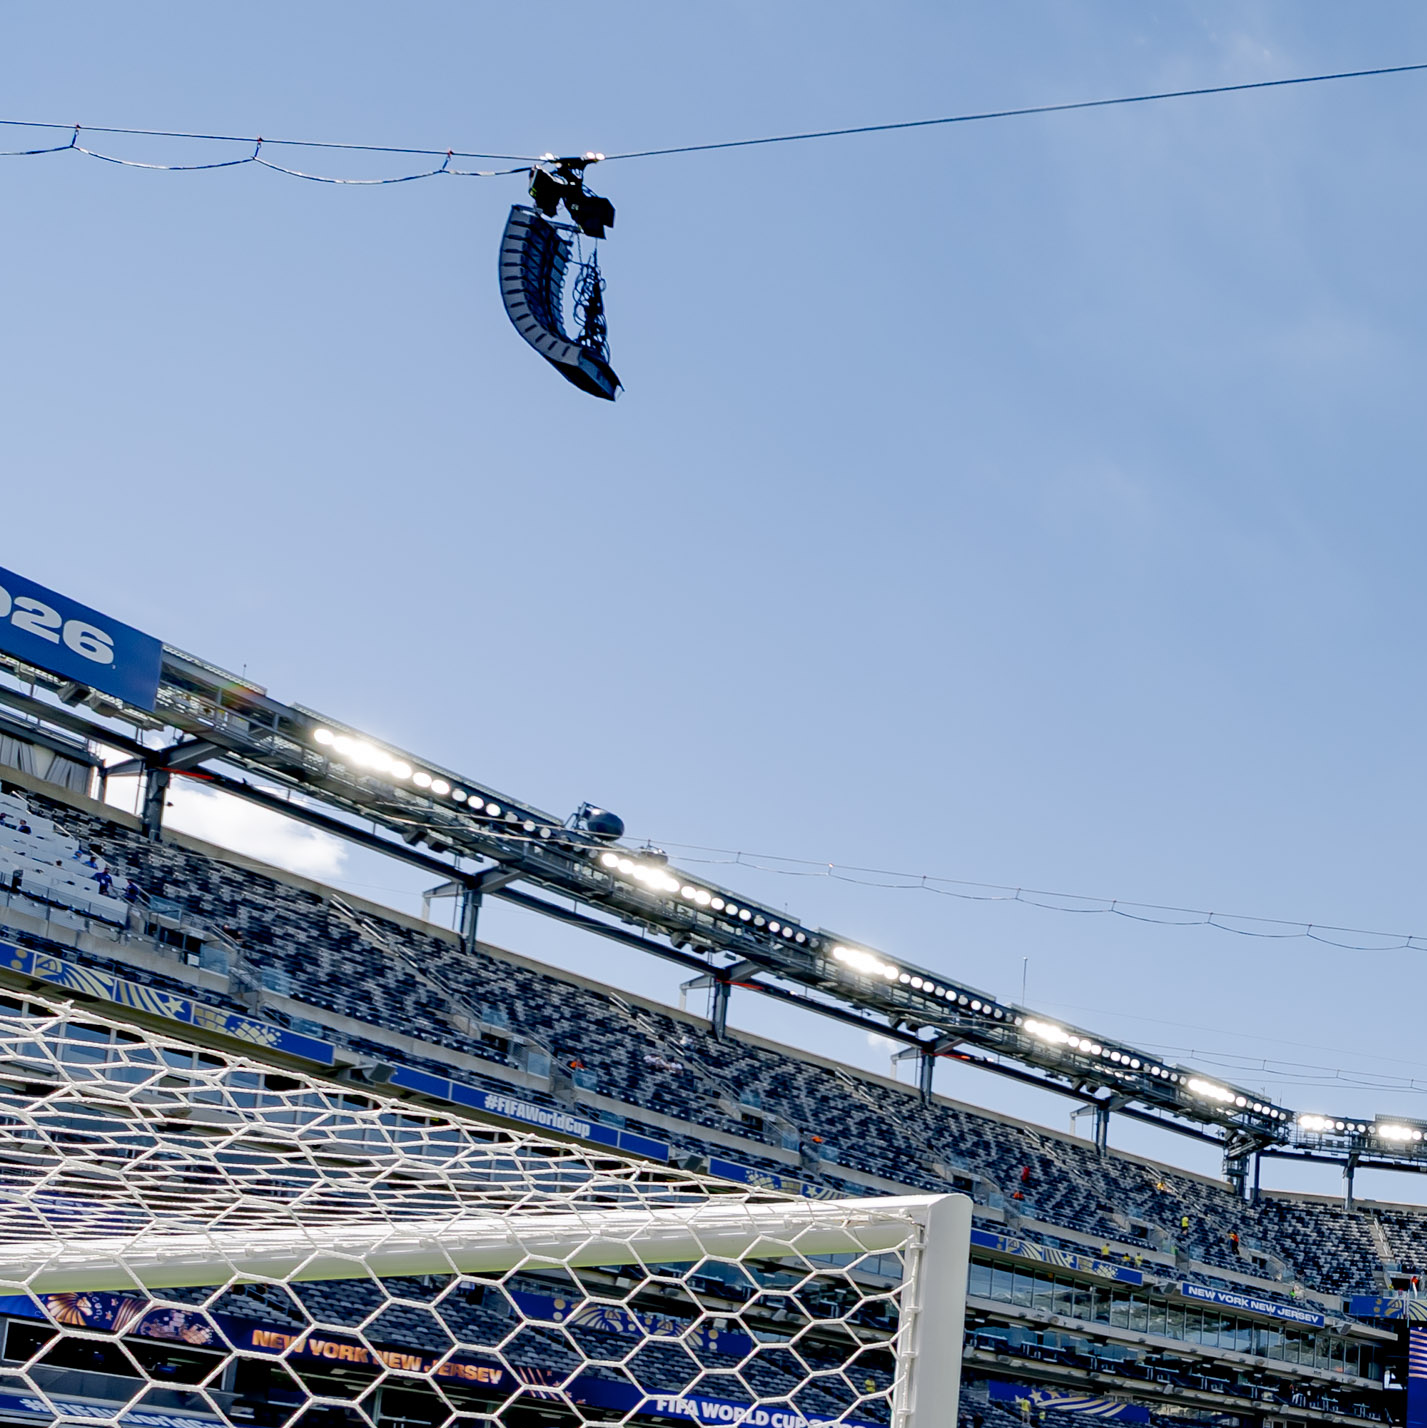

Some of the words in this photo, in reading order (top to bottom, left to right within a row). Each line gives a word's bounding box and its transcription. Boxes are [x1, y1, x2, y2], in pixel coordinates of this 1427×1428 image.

[0, 585, 115, 665] 26
[484, 1094, 590, 1138] #FIFAWorldCup
[1188, 1286, 1216, 1299] NEW
[1218, 1292, 1250, 1307] YORK
[1250, 1300, 1277, 1313] NEW
[1277, 1306, 1319, 1323] JERSEY
[252, 1329, 306, 1353] NEW
[309, 1338, 369, 1364] YORK
[374, 1350, 422, 1373] NEW
[424, 1358, 502, 1385] JERSEY
[656, 1398, 700, 1417] FIFA
[701, 1401, 770, 1426] WORLD
